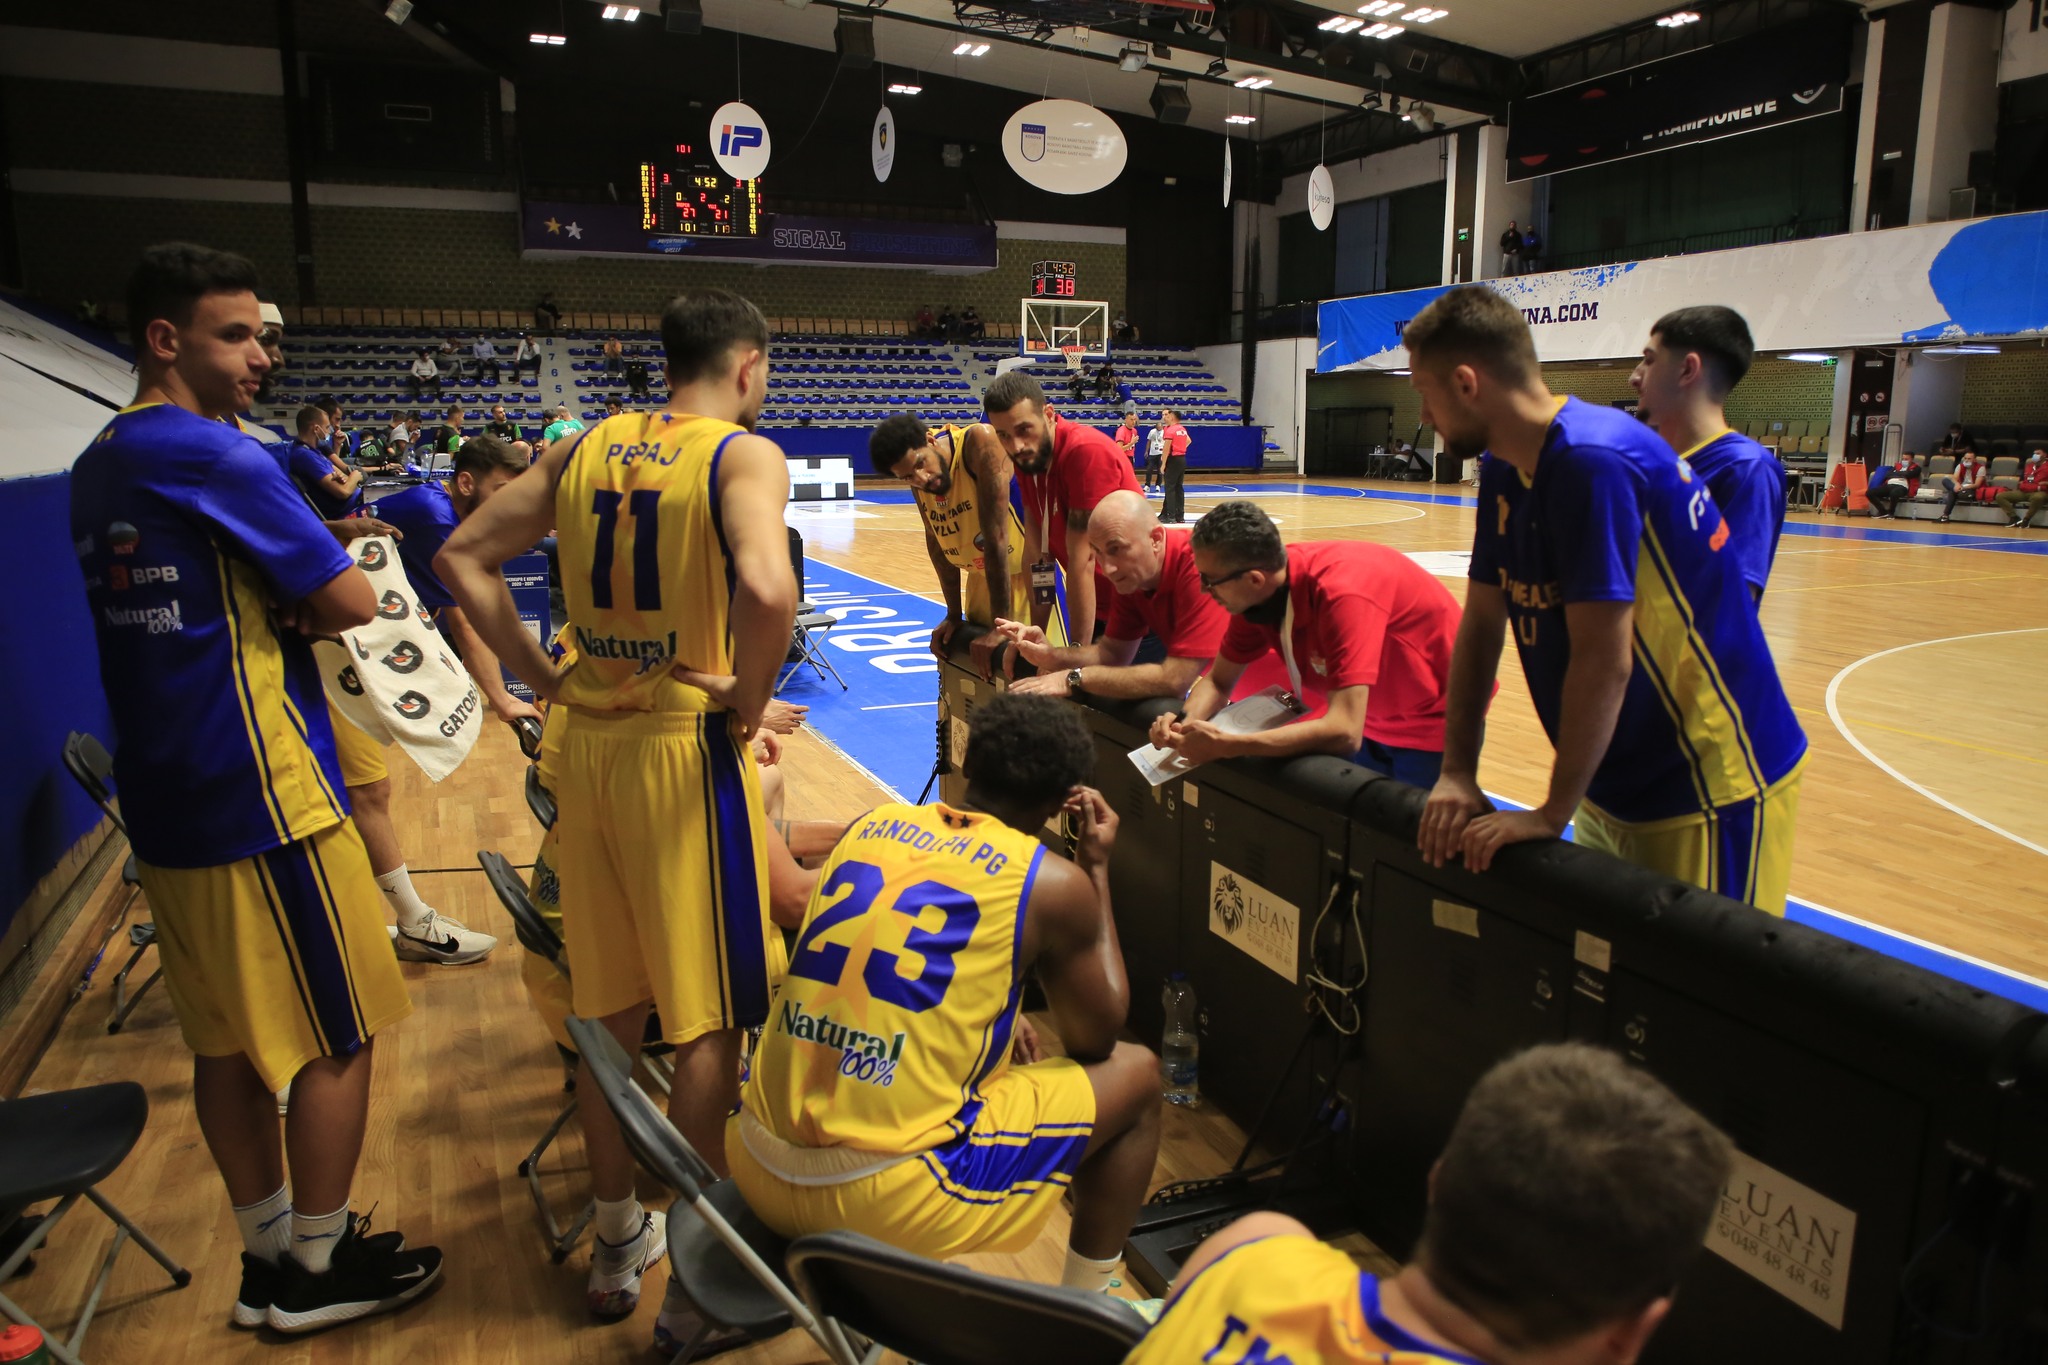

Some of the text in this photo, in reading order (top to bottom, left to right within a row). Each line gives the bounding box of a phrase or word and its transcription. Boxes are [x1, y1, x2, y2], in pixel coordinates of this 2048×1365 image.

[663, 173, 669, 183] 3
[695, 176, 717, 187] 4:52
[700, 193, 706, 202] 2
[683, 207, 728, 219] 27 21
[773, 228, 846, 250] SIGAL
[1052, 263, 1074, 274] 4:52
[1056, 279, 1074, 295] 38
[549, 353, 555, 361] 7
[962, 359, 968, 367] 7
[551, 368, 558, 377] 6
[971, 373, 978, 381] 6
[555, 384, 562, 393] 5
[591, 488, 662, 611] 11
[132, 566, 179, 584] BPB
[104, 599, 180, 625] Natural
[147, 616, 183, 634] 100%
[575, 626, 677, 661] Natural
[857, 819, 1008, 876] RANDOLPH PG
[1248, 896, 1295, 940] LUAN
[788, 859, 981, 1013] 23
[1247, 917, 1293, 953] EVENTS
[777, 999, 906, 1062] Natural
[836, 1047, 897, 1087] 100%
[1722, 1181, 1840, 1259] LUAN
[1720, 1200, 1833, 1277] EVENTS
[1731, 1228, 1830, 1300] 048 48 48 48
